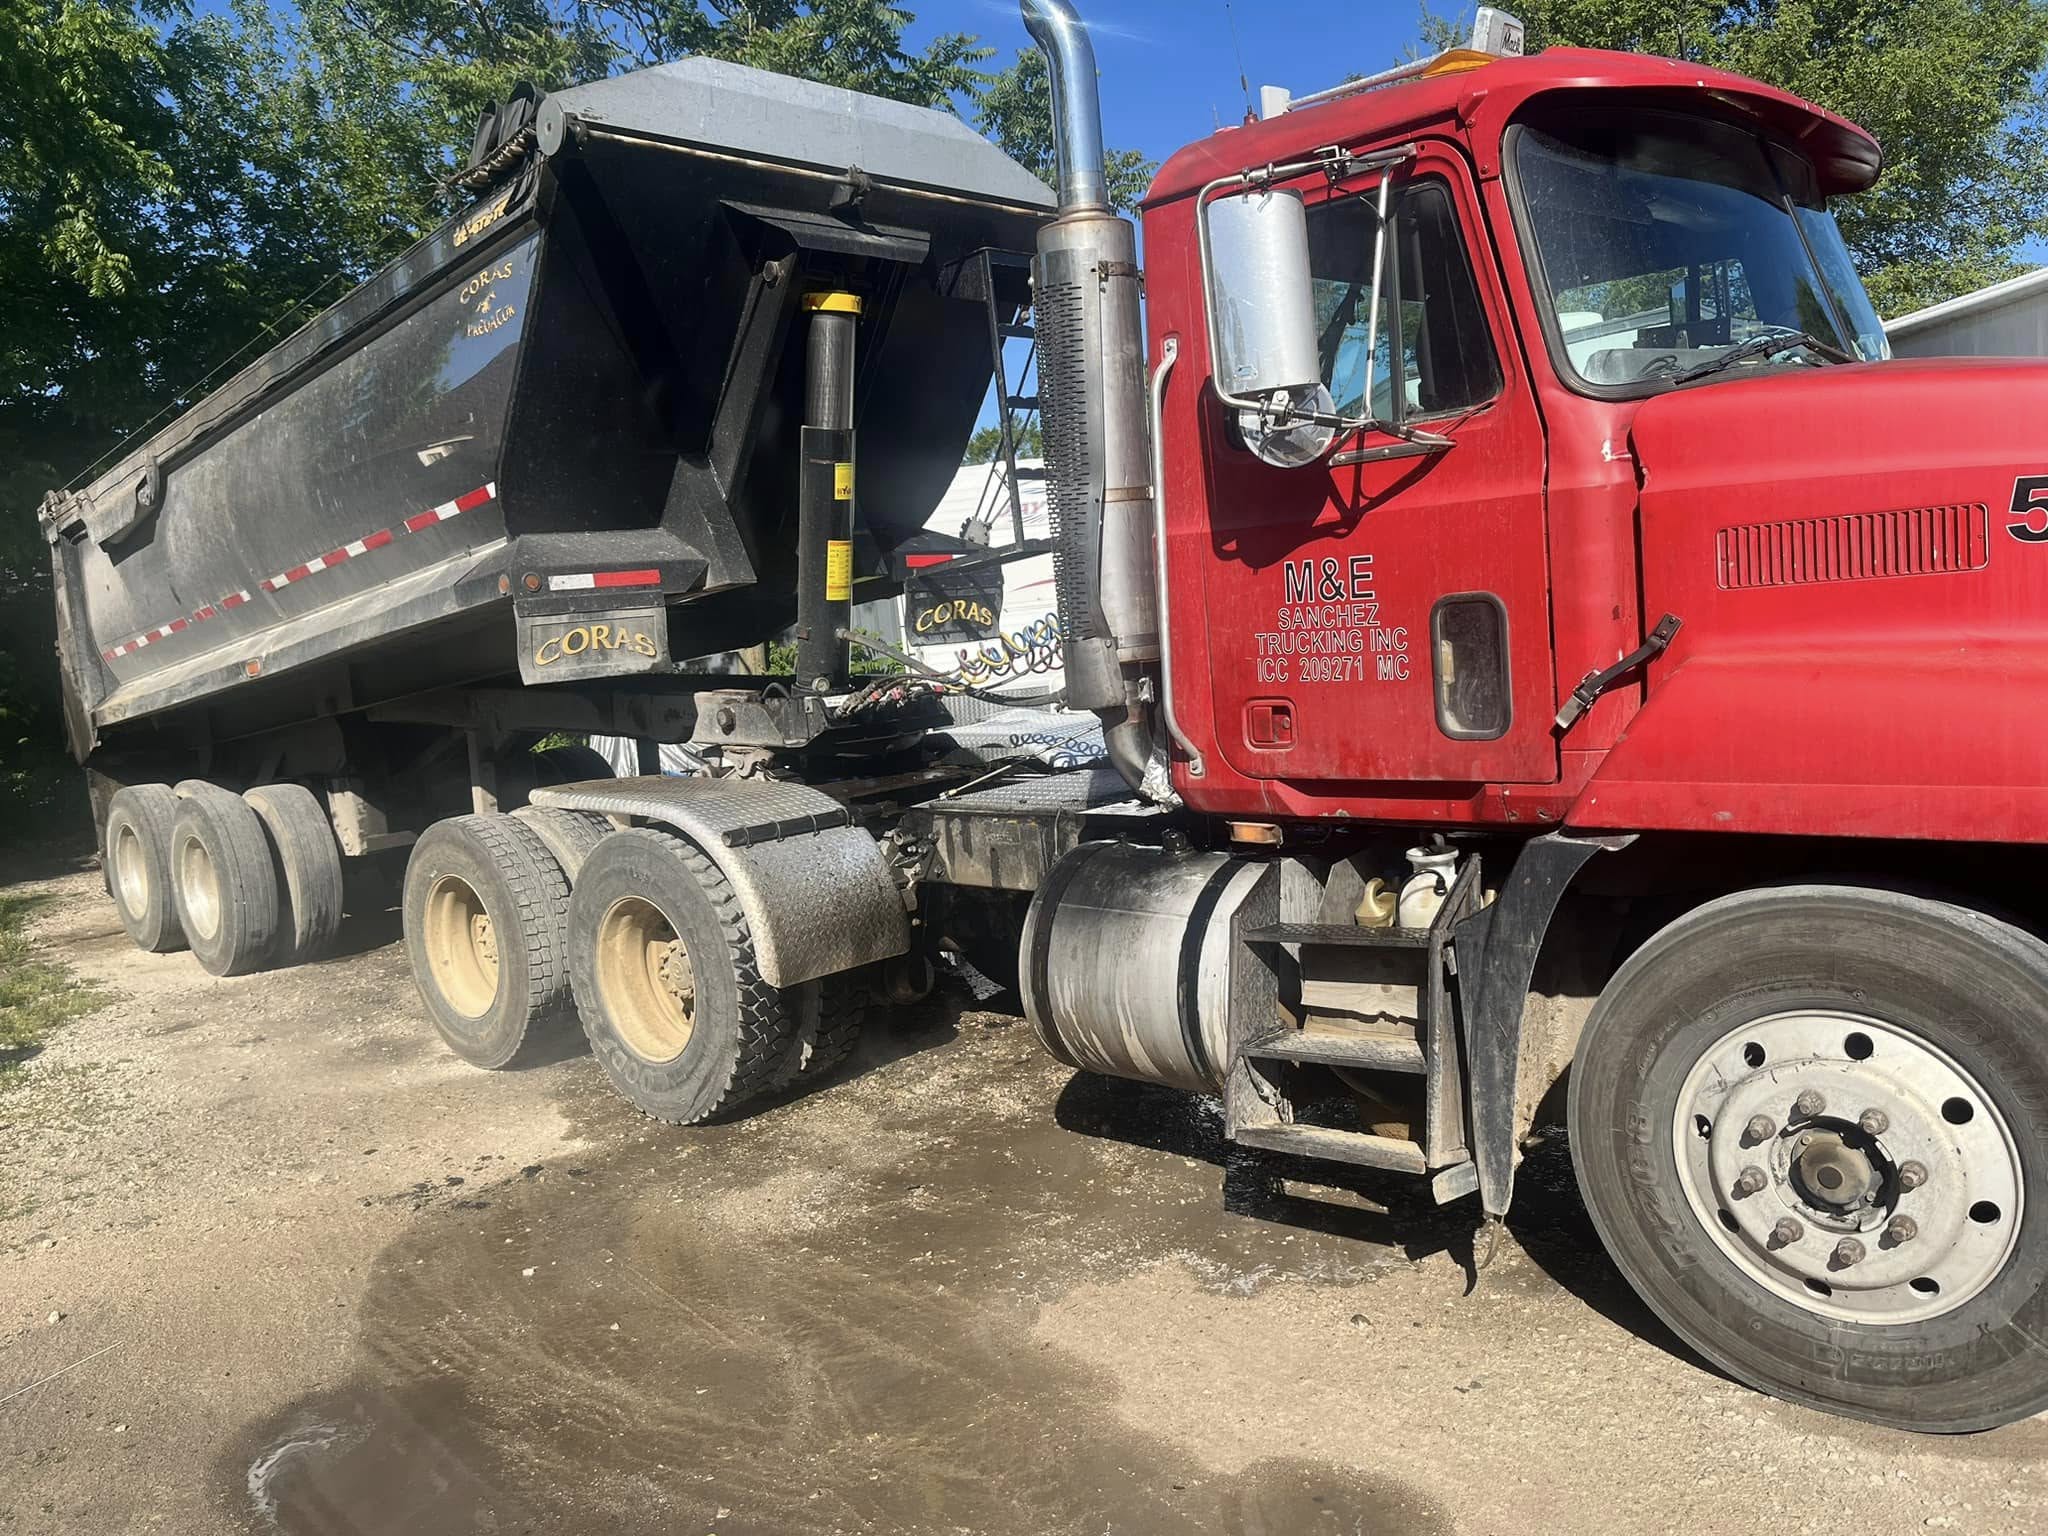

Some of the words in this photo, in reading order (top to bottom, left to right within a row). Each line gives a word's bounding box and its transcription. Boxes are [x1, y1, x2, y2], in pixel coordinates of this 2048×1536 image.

[460, 262, 513, 304] CORAS
[1284, 554, 1376, 604] M&E
[916, 600, 994, 633] CORAS
[1278, 602, 1381, 630] SANCHEZ
[535, 625, 657, 666] CORAS
[1255, 630, 1364, 655] TRUCKING
[1369, 626, 1409, 652] INC
[1257, 658, 1289, 683] ICC
[1299, 656, 1364, 683] 209271
[1376, 654, 1410, 681] MC
